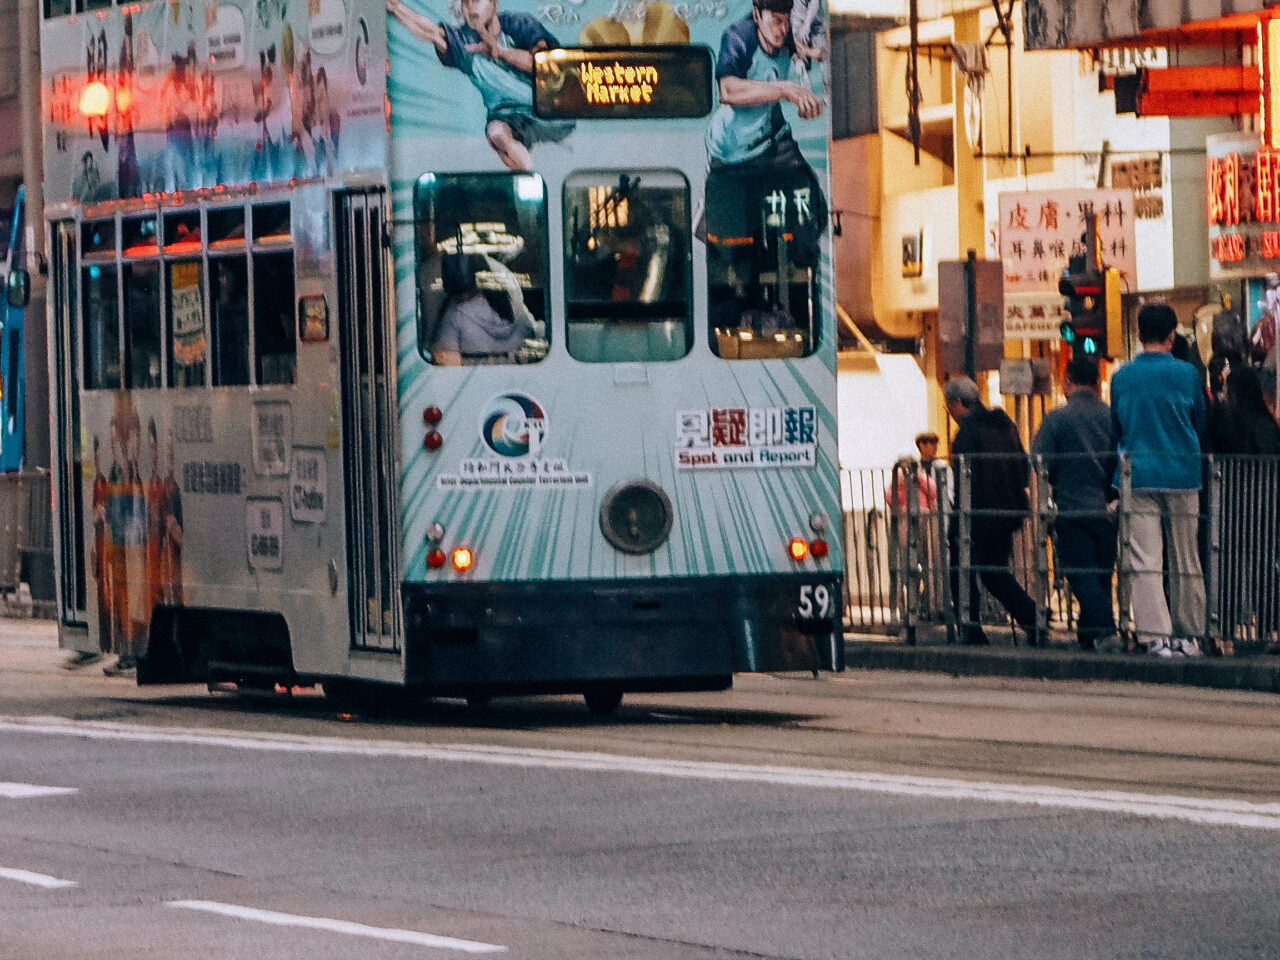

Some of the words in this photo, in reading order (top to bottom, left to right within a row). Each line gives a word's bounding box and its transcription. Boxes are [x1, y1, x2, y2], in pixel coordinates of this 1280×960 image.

[580, 61, 658, 84] Western
[585, 81, 653, 104] Market
[678, 451, 718, 465] Spot
[723, 450, 754, 464] and
[759, 449, 810, 465] Report
[798, 584, 829, 619] 59
